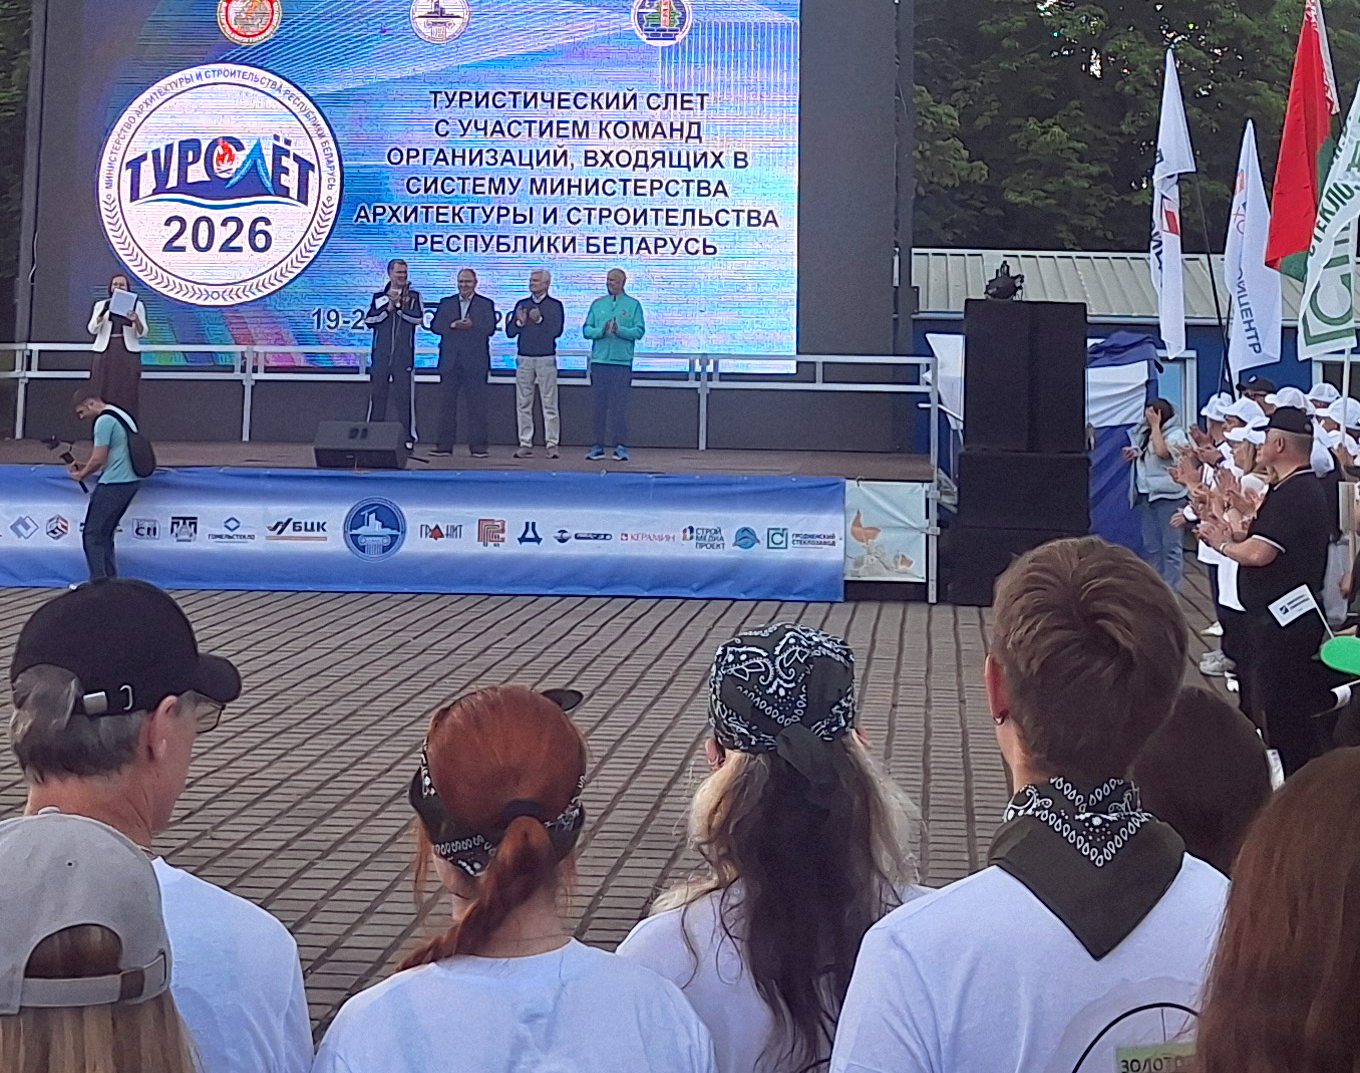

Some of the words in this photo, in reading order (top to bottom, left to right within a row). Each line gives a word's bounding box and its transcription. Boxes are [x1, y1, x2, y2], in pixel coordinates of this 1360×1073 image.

[429, 87, 638, 111] ТУРИСТИЧЕСКИЙ
[646, 92, 710, 111] СЛЕТ
[105, 115, 137, 190] МИНИСТЕРСТВО
[135, 76, 195, 118] АРХИТЕКТУРЫ
[204, 68, 284, 94] СТРОИТЕЛЬСТВА
[282, 88, 327, 139] РЕСПУБЛИКИ
[321, 139, 335, 191] БЕЛАРУСЬ
[434, 119, 450, 138] С
[458, 119, 590, 139] УЧАСТИЕМ
[598, 120, 703, 144] КОМАНД
[386, 144, 576, 171] ОРГАНИЗАЦИЙ,
[583, 149, 726, 172] ВХОДЯЩИХ
[733, 151, 750, 169] В
[405, 176, 522, 196] СИСТЕМУ
[529, 177, 729, 198] МИНИСТЕРСТВА
[353, 205, 534, 225] АРХИТЕКТУРЫ
[542, 206, 558, 225] И
[566, 206, 780, 228] СТРОИТЕЛЬСТВА
[161, 215, 274, 253] 2026
[413, 234, 577, 254] РЕСПУБЛИКИ
[586, 235, 718, 256] БЕЛАРУСЬ
[310, 307, 367, 330] 19-2
[292, 521, 328, 532] БЦК
